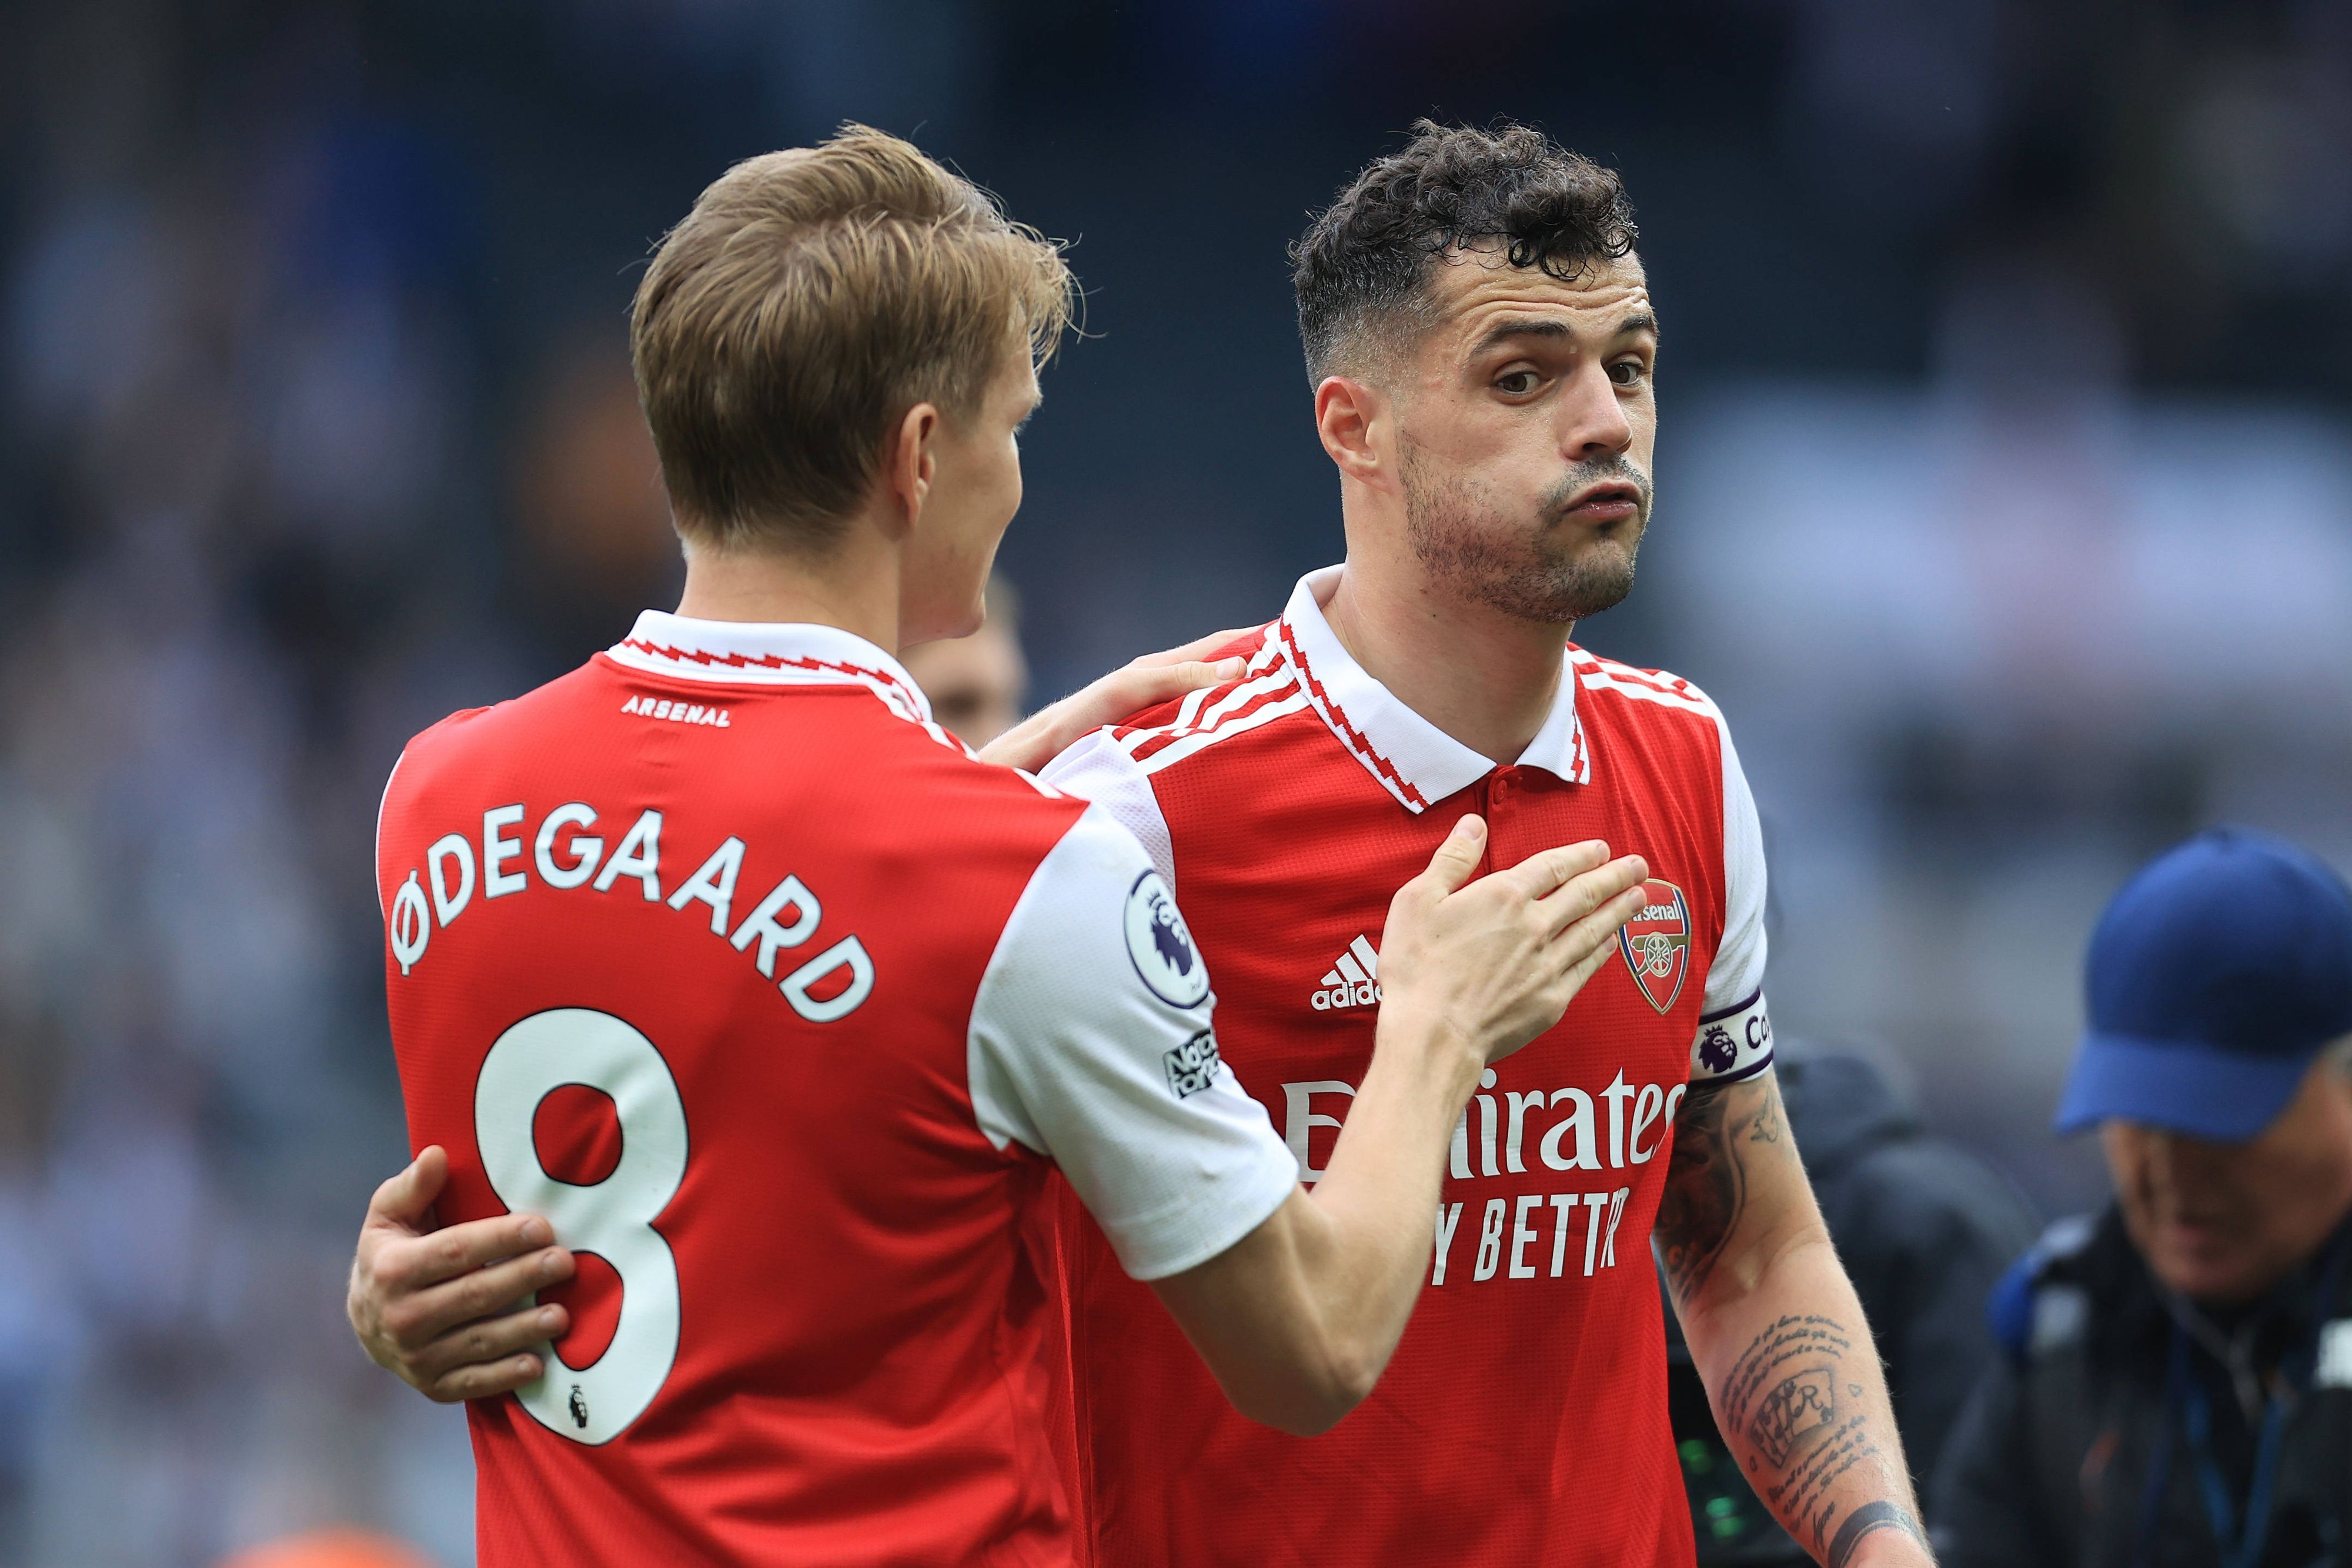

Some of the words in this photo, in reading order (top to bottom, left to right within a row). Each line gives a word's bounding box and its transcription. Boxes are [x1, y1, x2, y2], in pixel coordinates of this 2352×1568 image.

[620, 695, 730, 728] ARSENAL
[390, 802, 876, 1023] ØDEGAARD
[1631, 900, 1681, 922] senal
[1311, 978, 1383, 1010] adid
[1281, 1066, 1686, 1182] Eirate
[474, 1007, 690, 1446] 8
[1473, 1187, 1630, 1282] BETTR
